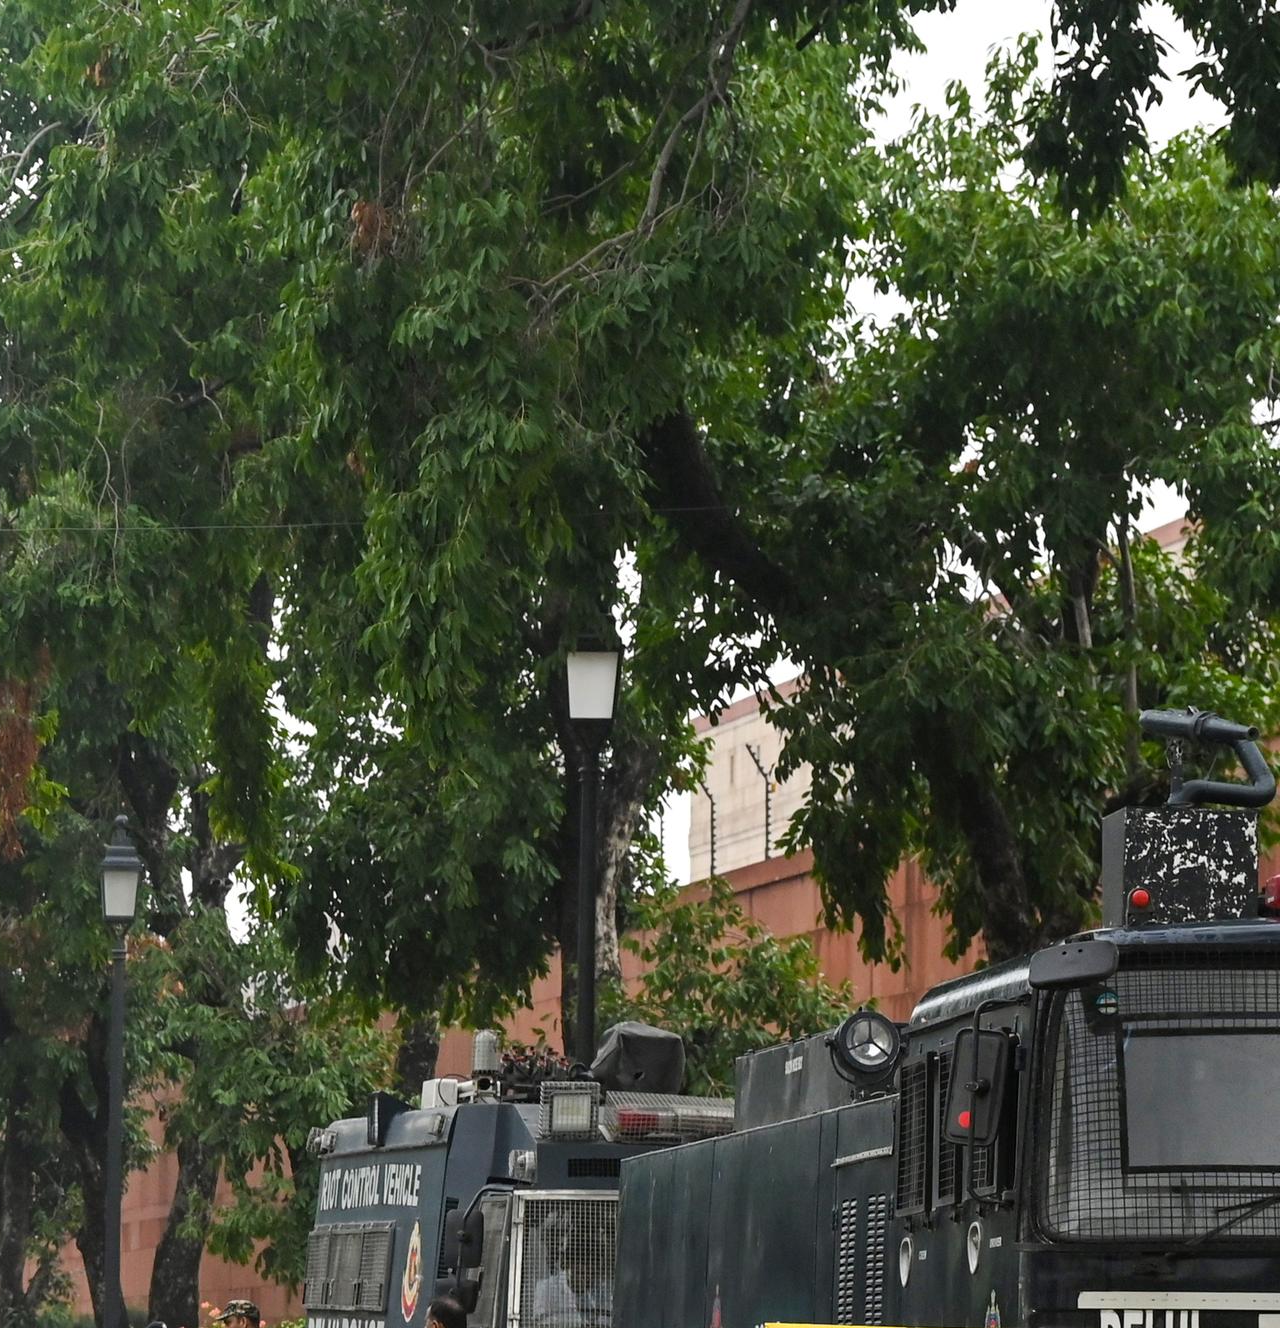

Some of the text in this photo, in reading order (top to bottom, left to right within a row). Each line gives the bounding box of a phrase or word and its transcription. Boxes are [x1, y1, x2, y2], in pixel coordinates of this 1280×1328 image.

[320, 1163, 422, 1211] RIOT CONTROL VEHICLE
